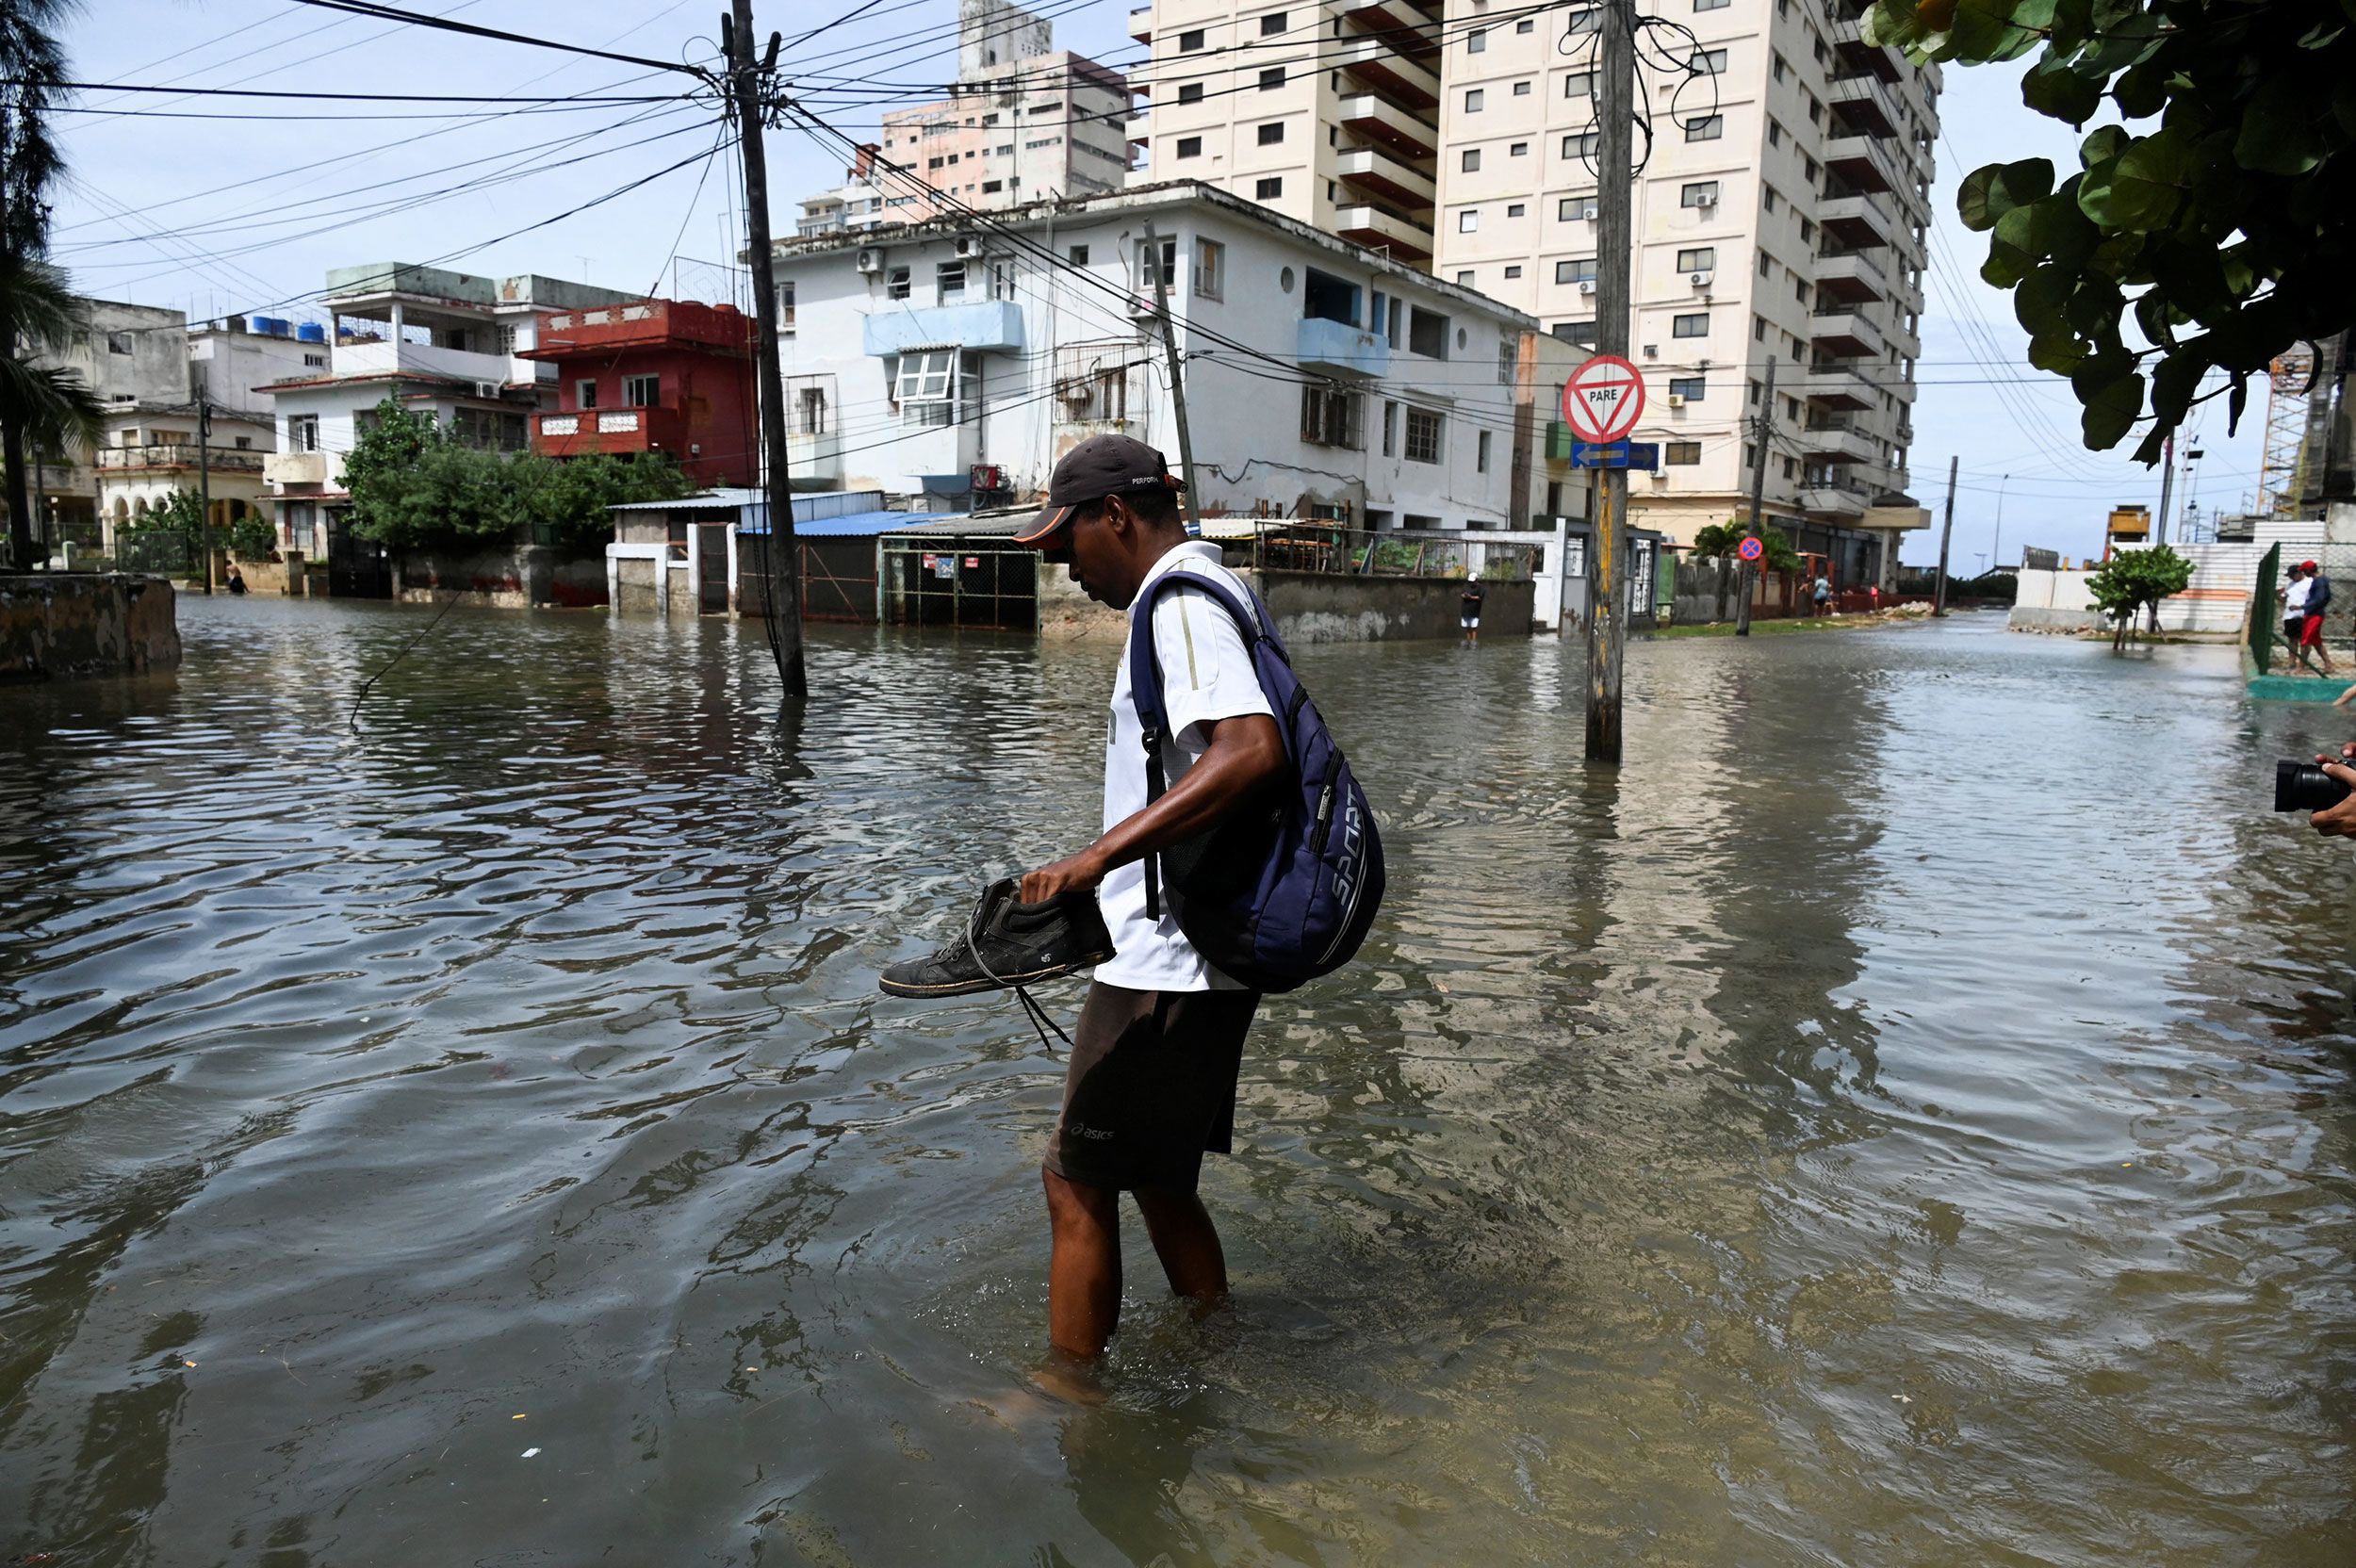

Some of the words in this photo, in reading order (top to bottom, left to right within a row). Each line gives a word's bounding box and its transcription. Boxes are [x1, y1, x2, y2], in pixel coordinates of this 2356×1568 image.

[1590, 389, 1617, 402] PARE
[1332, 784, 1362, 906] SPORT
[1084, 1128, 1115, 1139] asics
